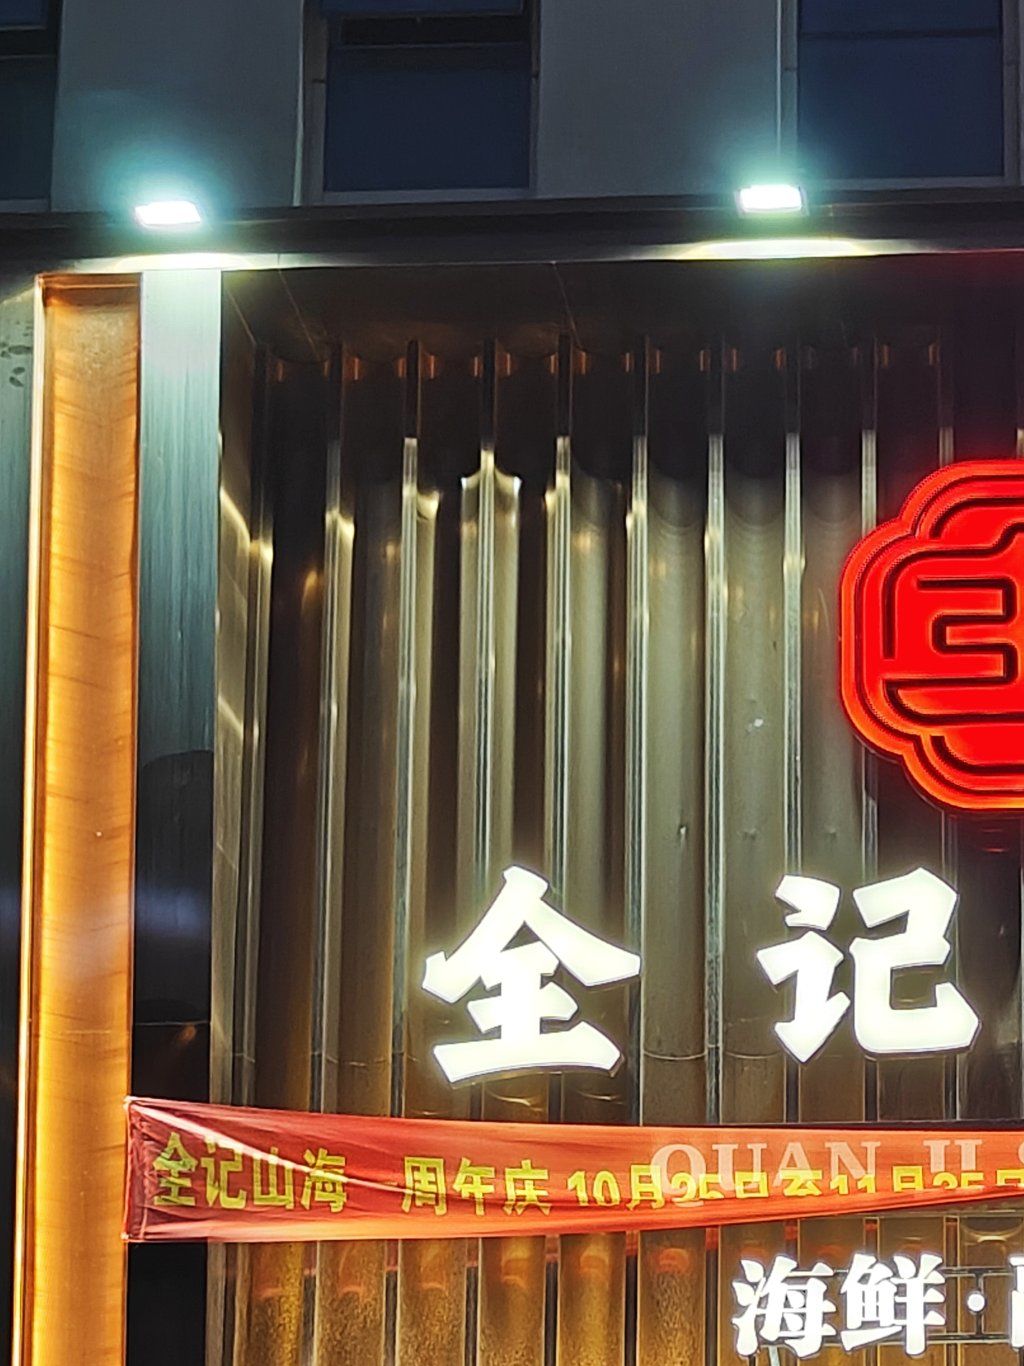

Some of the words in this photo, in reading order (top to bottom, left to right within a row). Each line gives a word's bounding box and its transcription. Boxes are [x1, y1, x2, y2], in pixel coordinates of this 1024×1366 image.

[152, 1131, 348, 1213] 全记山海
[384, 1155, 552, 1217] 周年庆
[651, 1139, 881, 1207] QUAN
